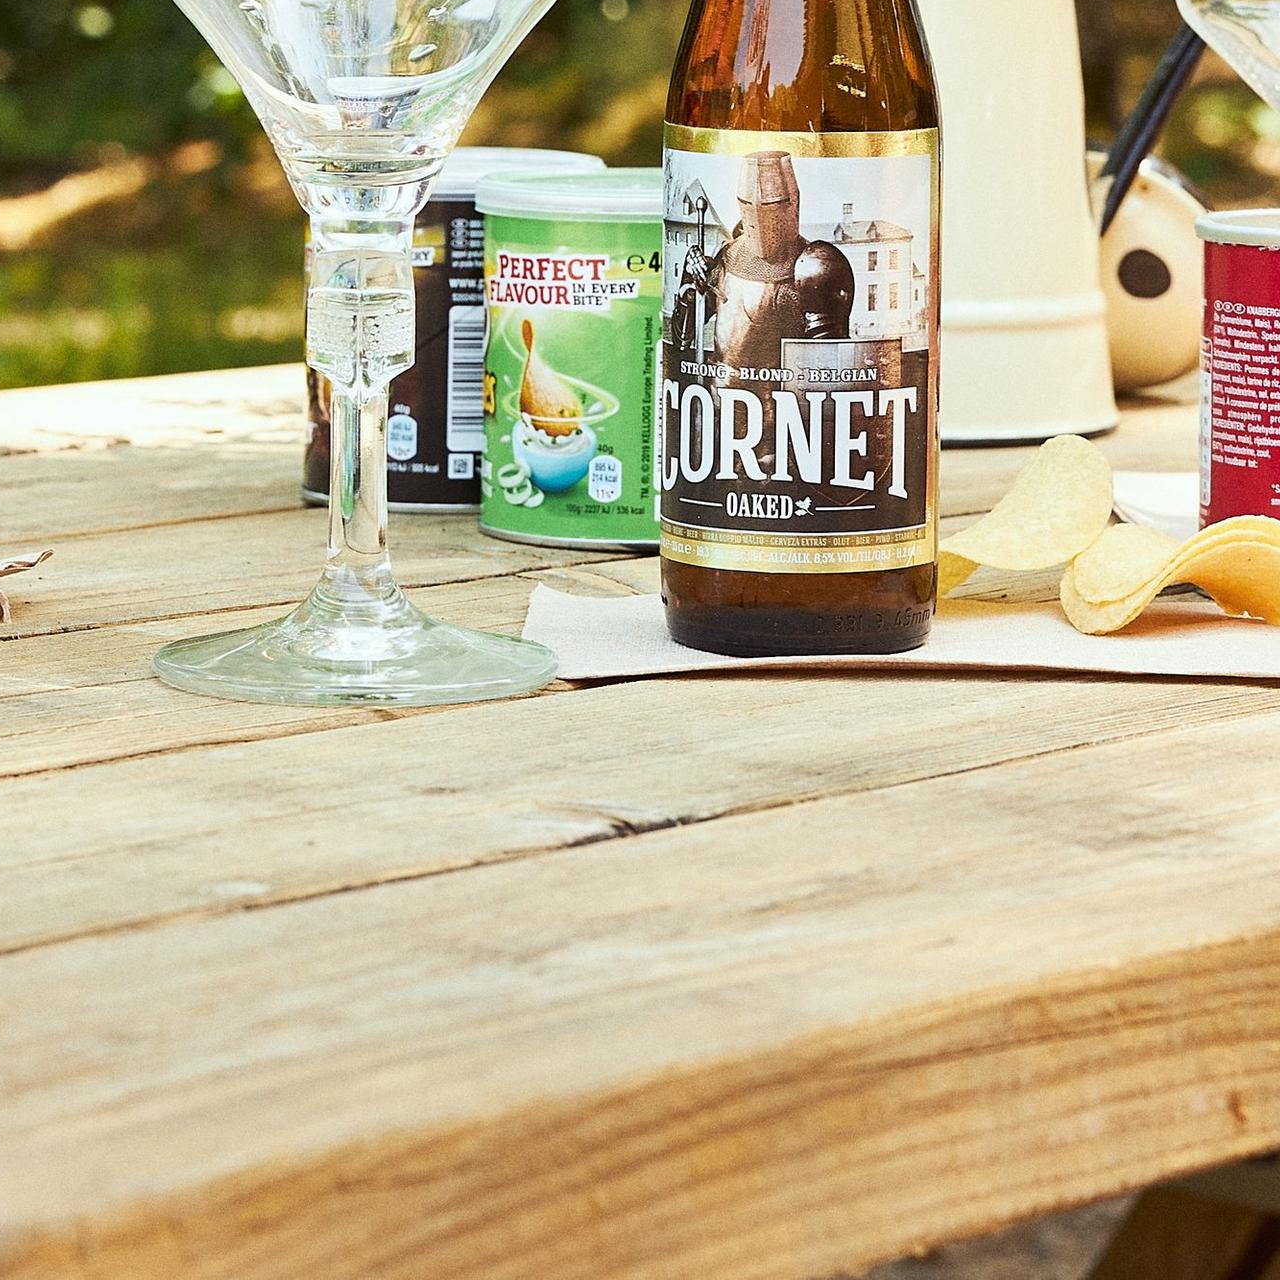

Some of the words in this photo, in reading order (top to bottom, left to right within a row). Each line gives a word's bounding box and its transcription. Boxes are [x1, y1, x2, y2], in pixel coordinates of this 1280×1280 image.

[499, 254, 605, 282] PERFECT
[490, 280, 570, 306] FLAVOUR
[572, 283, 586, 294] IN
[591, 282, 636, 294] EVERY
[641, 347, 653, 375] Trading
[680, 361, 729, 380] STRONG
[739, 368, 794, 382] BLOND
[809, 368, 878, 382] BELGIAN
[641, 377, 653, 404] Europe
[641, 405, 651, 444] KELLOGG
[661, 378, 918, 499] CORNET
[726, 492, 794, 520] OAKED
[770, 536, 800, 547] CERVEZA
